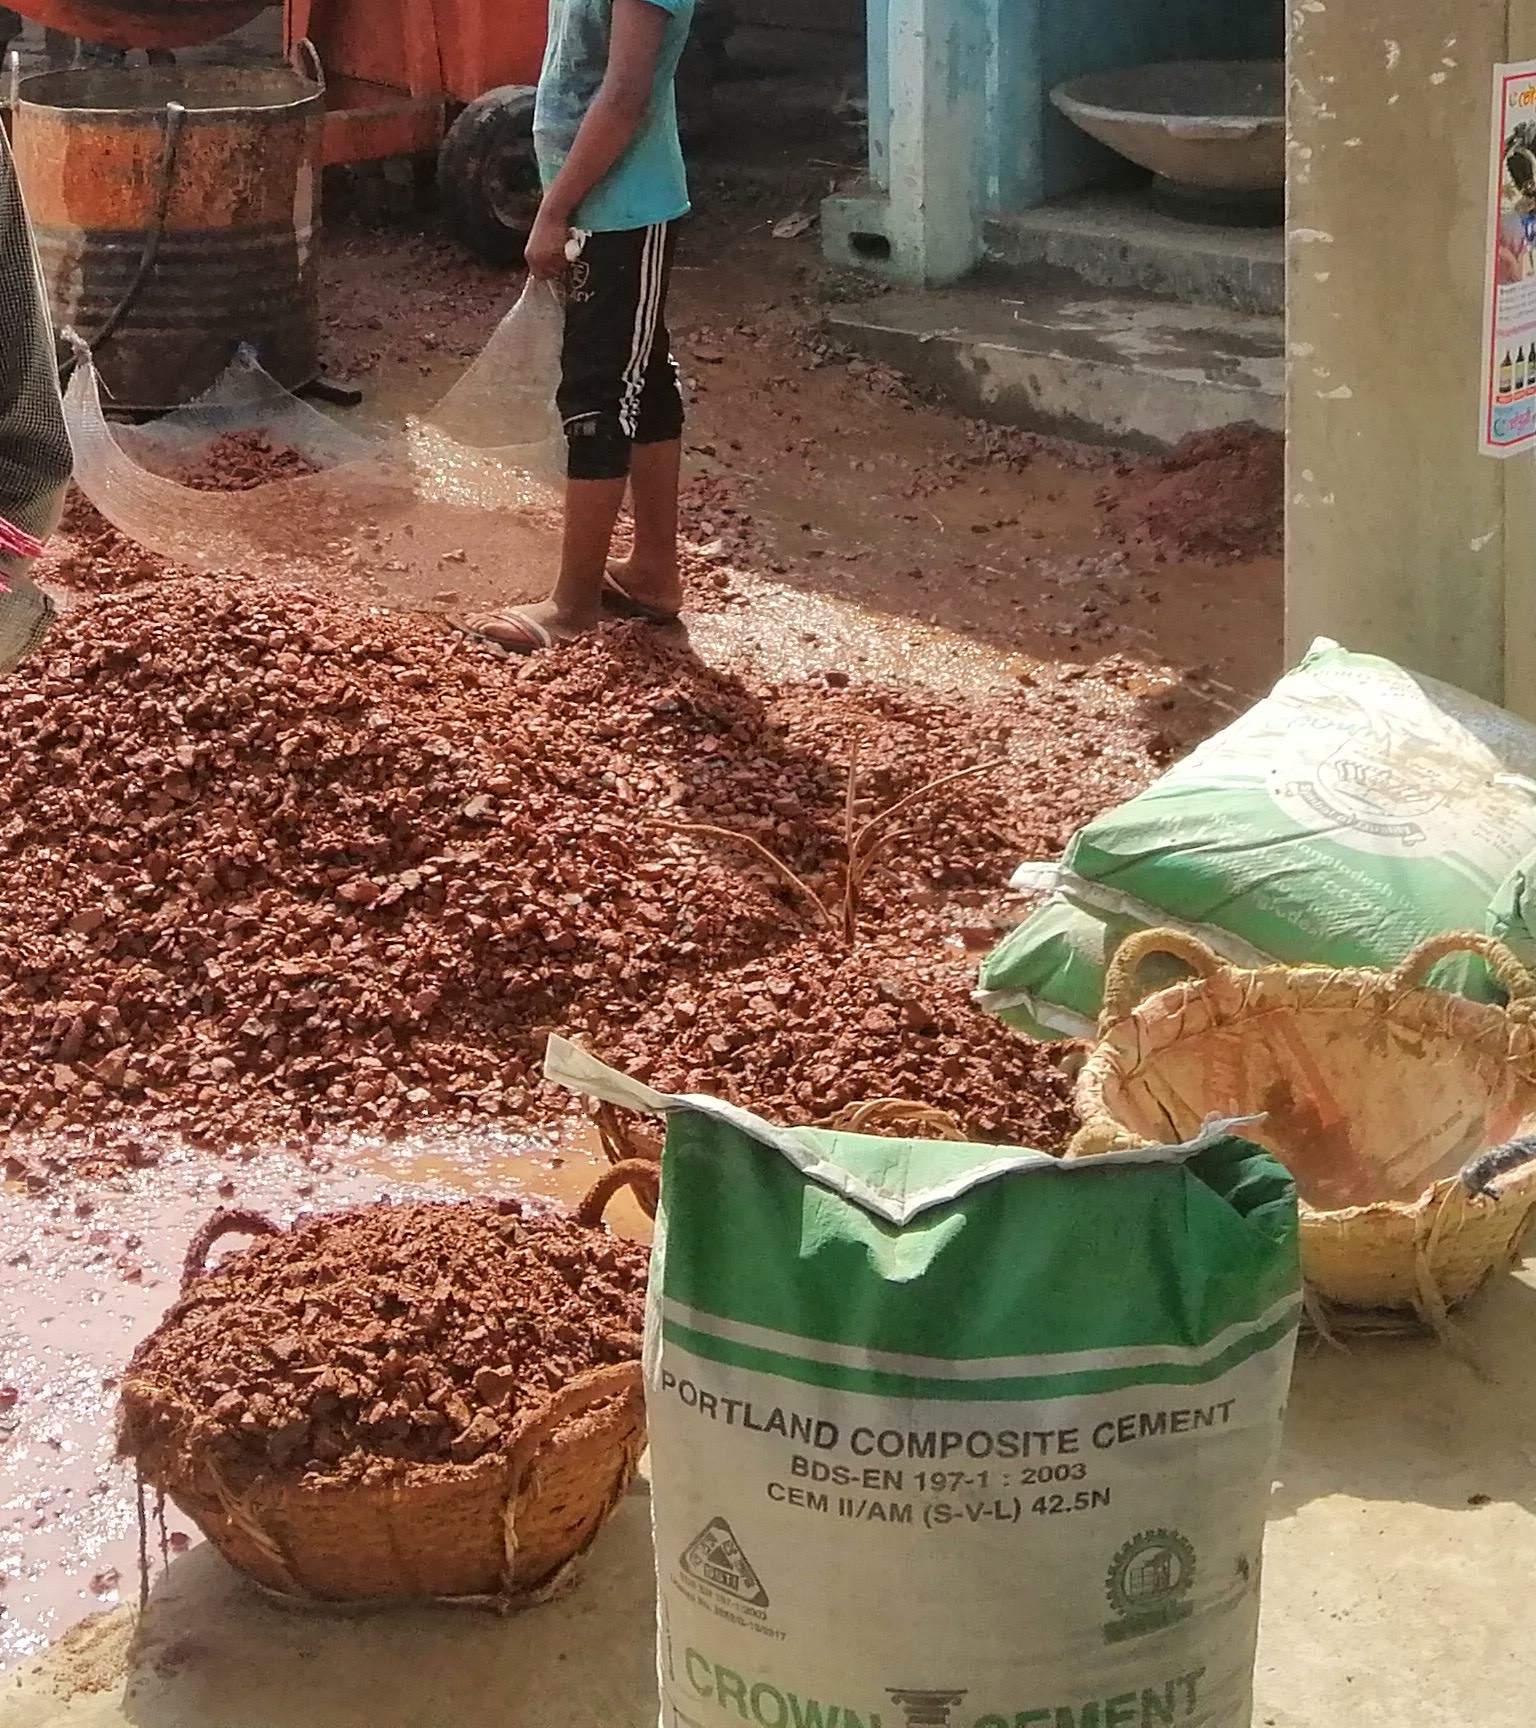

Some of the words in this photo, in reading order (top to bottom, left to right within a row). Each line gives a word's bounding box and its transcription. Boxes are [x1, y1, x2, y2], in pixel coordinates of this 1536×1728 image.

[661, 1369, 839, 1451] PORTLAND
[850, 1426, 1080, 1460] COMPOSITE
[1092, 1398, 1237, 1450] CEMENT
[791, 1454, 903, 1491] BDS-EN
[914, 1470, 989, 1493] 197-1
[1021, 1462, 1088, 1486] 2003
[766, 1482, 829, 1513] CEM
[923, 1497, 1023, 1530] (S-V-L)
[1030, 1487, 1112, 1516] 42.5N
